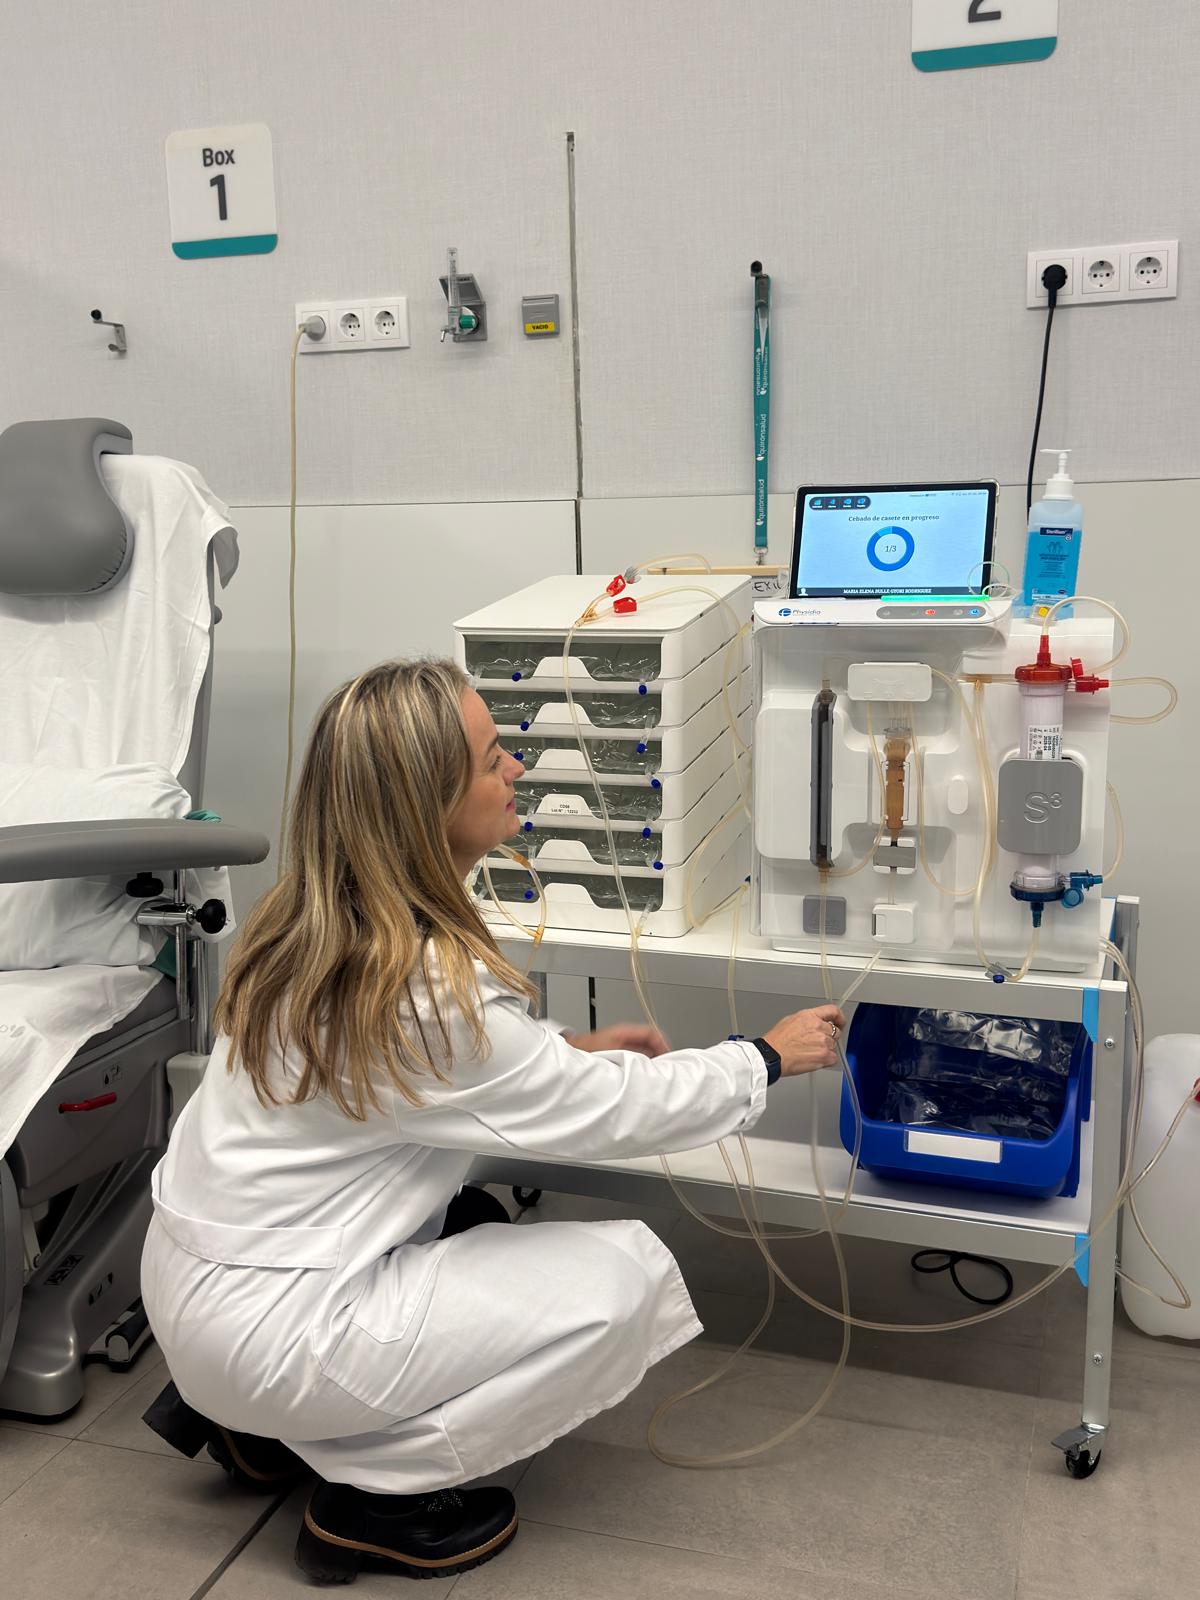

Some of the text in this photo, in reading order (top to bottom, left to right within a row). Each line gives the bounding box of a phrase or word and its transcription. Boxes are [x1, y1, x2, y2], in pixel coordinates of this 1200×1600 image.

[202, 148, 235, 167] Box
[210, 174, 227, 221] 1
[911, 515, 939, 523] progreso
[885, 545, 897, 553] 1/3
